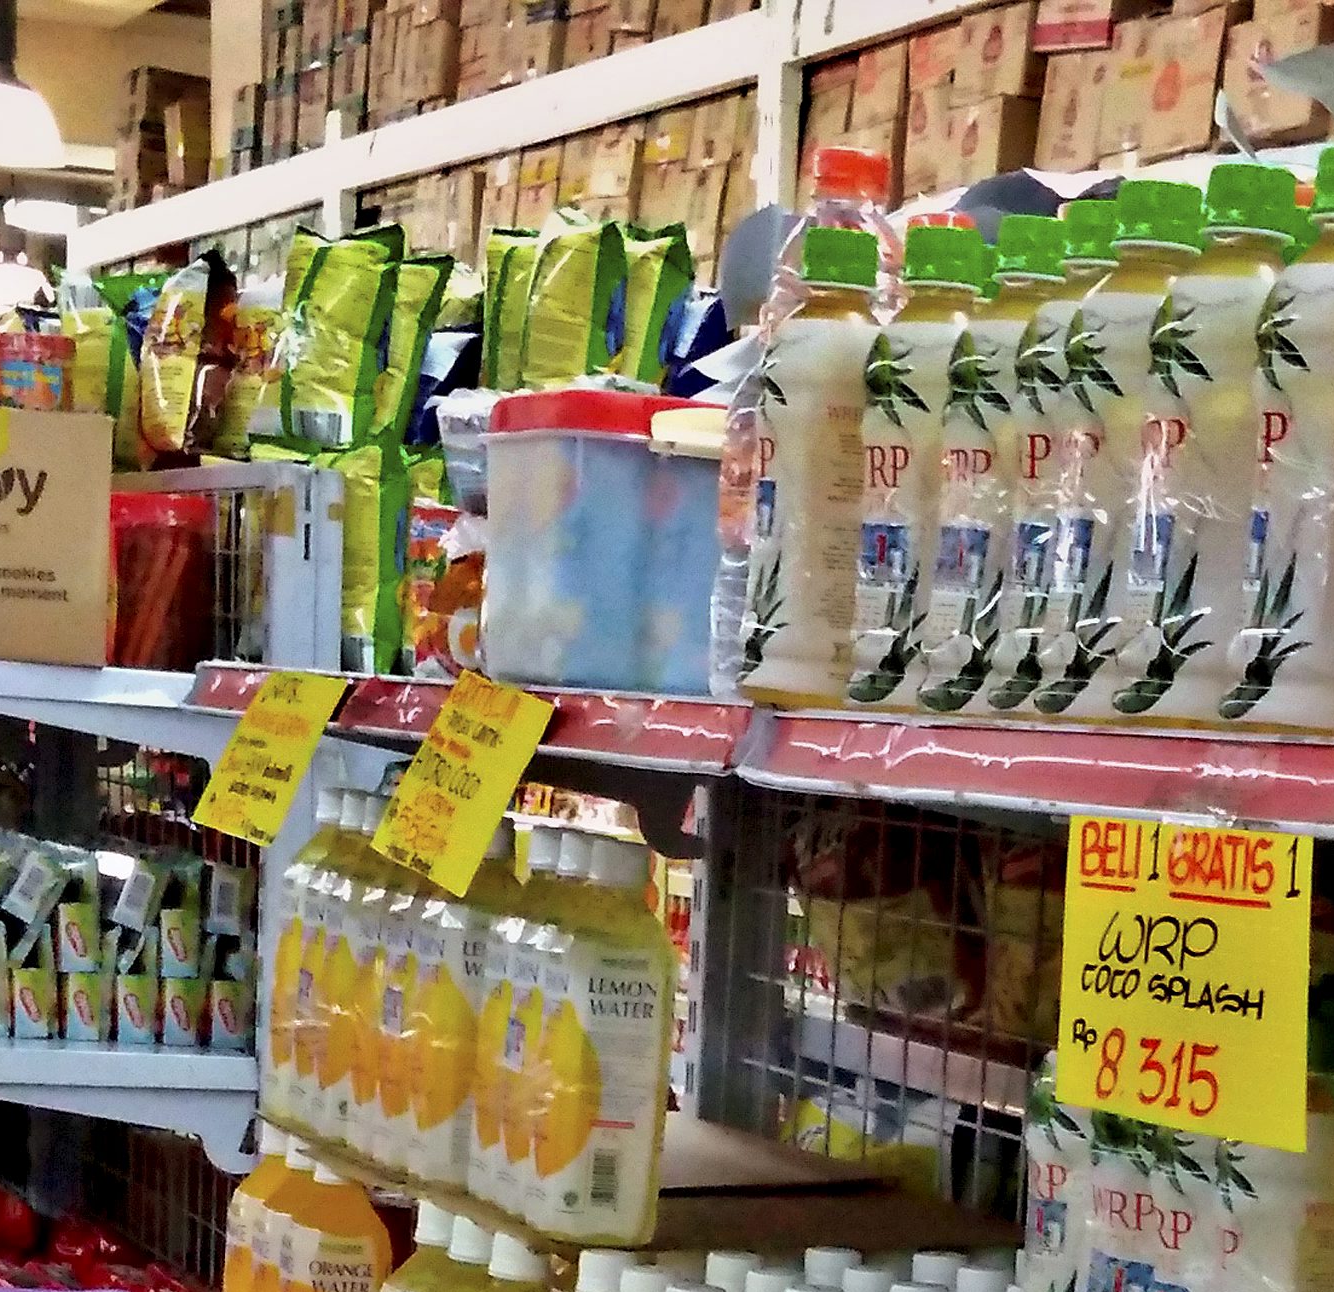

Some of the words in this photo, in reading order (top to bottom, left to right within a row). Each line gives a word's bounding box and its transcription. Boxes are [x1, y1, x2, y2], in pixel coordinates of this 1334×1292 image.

[866, 446, 910, 488] RP
[1080, 820, 1142, 879] BELI
[1147, 823, 1161, 881] 1
[1168, 830, 1274, 895] GRATIS
[1285, 836, 1301, 898] 1
[1098, 911, 1219, 971] WRP
[587, 976, 658, 998] LEMON
[1081, 963, 1141, 999] COCO
[1148, 973, 1265, 1020] SPLASH
[589, 998, 655, 1019] WATER
[1072, 1018, 1098, 1053] Rp
[309, 1259, 375, 1279] ORANGE
